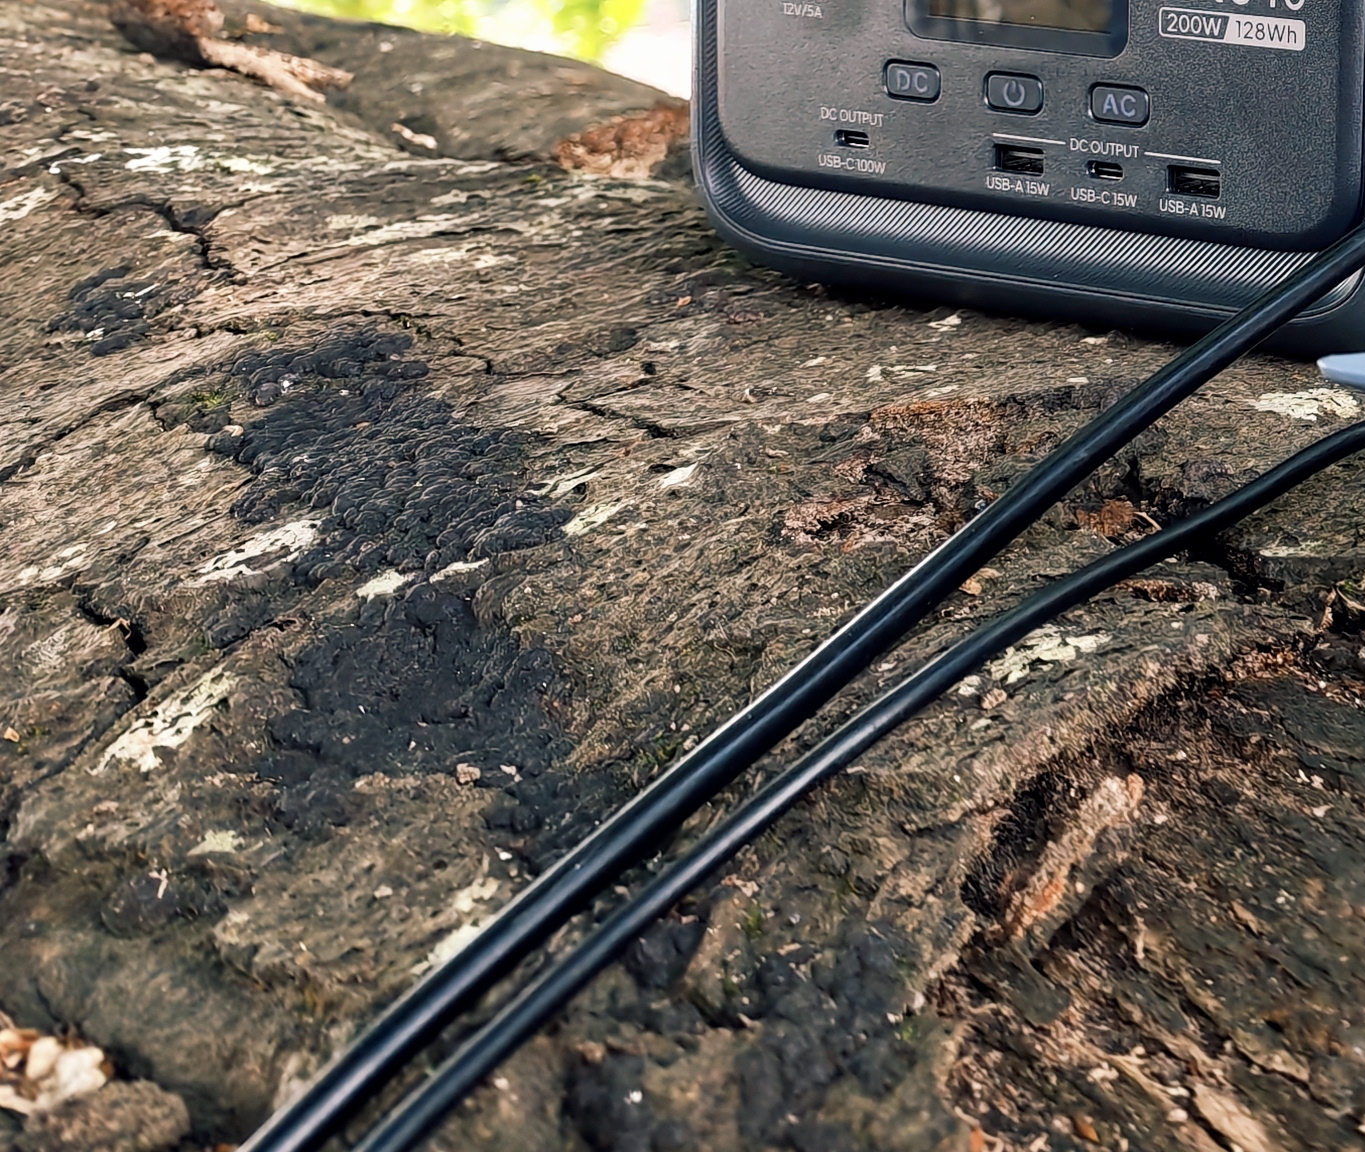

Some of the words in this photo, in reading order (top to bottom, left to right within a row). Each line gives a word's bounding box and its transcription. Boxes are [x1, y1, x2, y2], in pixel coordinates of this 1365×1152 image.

[782, 2, 823, 18] 12V/5A
[1166, 13, 1222, 36] 200W
[1235, 20, 1297, 44] 128Wh
[896, 70, 928, 93] DC
[1102, 93, 1136, 117] AC
[820, 107, 837, 120] DC
[839, 109, 884, 127] OUTPUT
[1070, 138, 1089, 152] DC
[1090, 140, 1139, 158] OUTPUT
[818, 153, 855, 170] USB-C
[856, 158, 886, 175] 100W
[986, 176, 1024, 193] USB-A
[1026, 181, 1050, 197] 15W
[1071, 187, 1111, 204] USB-C
[1112, 192, 1138, 208] 15W
[1159, 199, 1199, 216] USB-A
[1201, 204, 1226, 219] 15W
